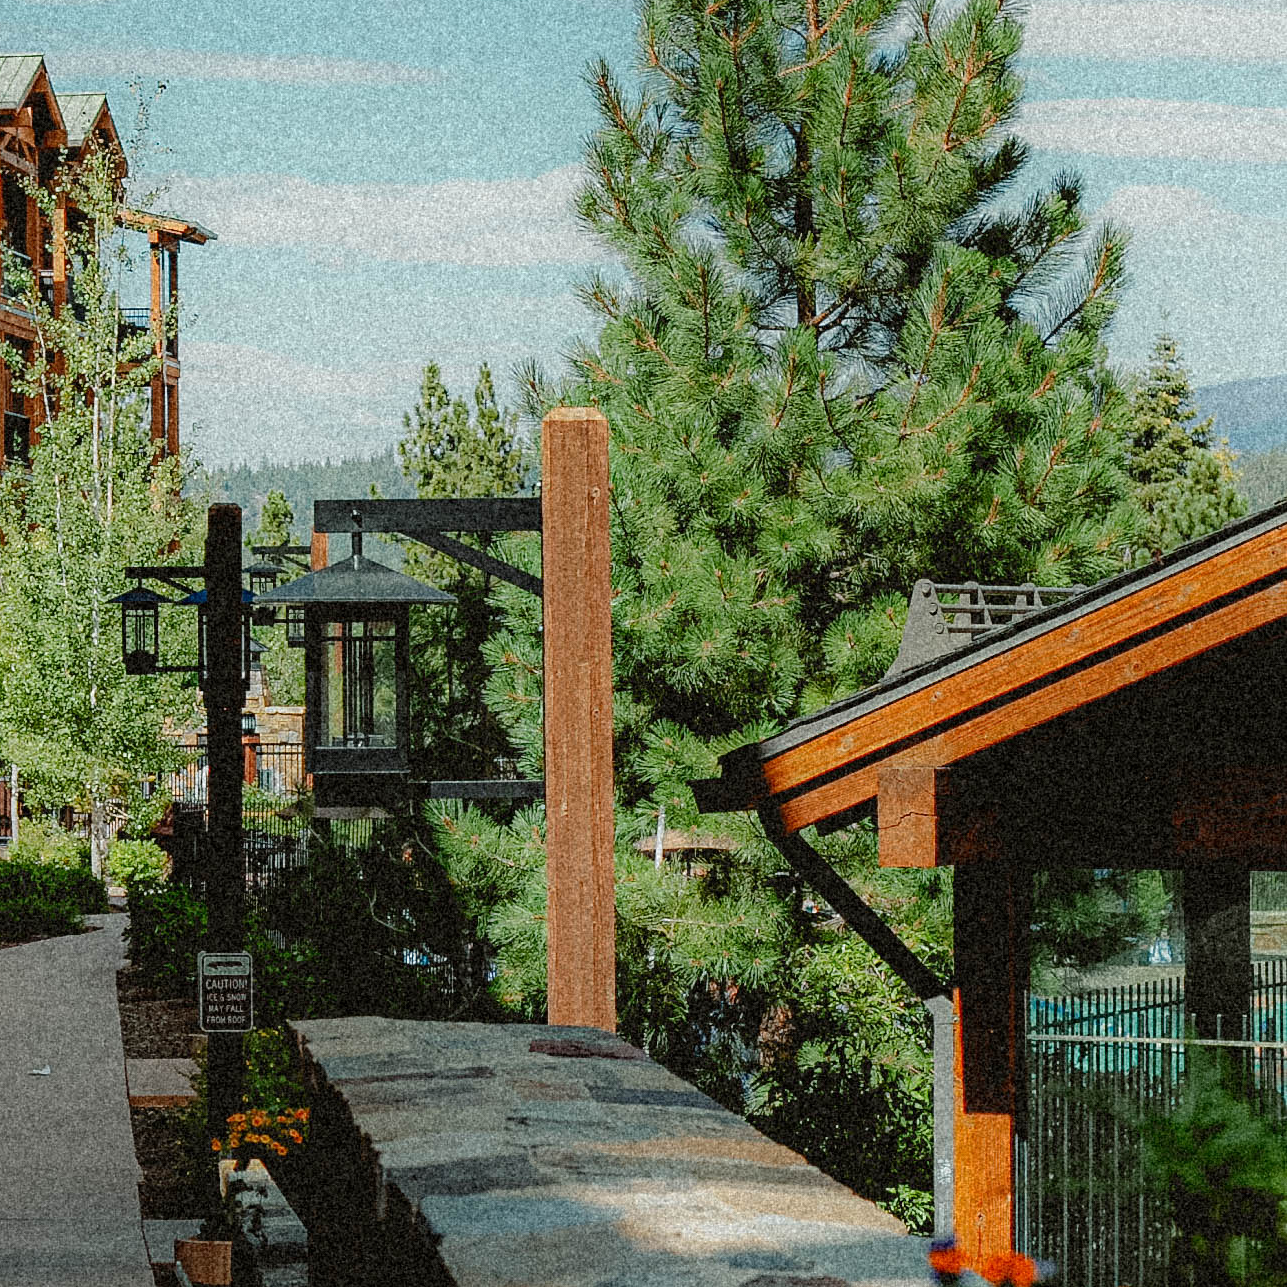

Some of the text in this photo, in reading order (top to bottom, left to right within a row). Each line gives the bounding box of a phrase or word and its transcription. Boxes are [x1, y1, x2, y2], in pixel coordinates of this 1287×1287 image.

[205, 978, 248, 990] CAUTION!
[206, 993, 247, 1002] ICE & SNOW
[208, 1004, 244, 1013] MAY FALL
[206, 1015, 246, 1024] FROM ROOF
